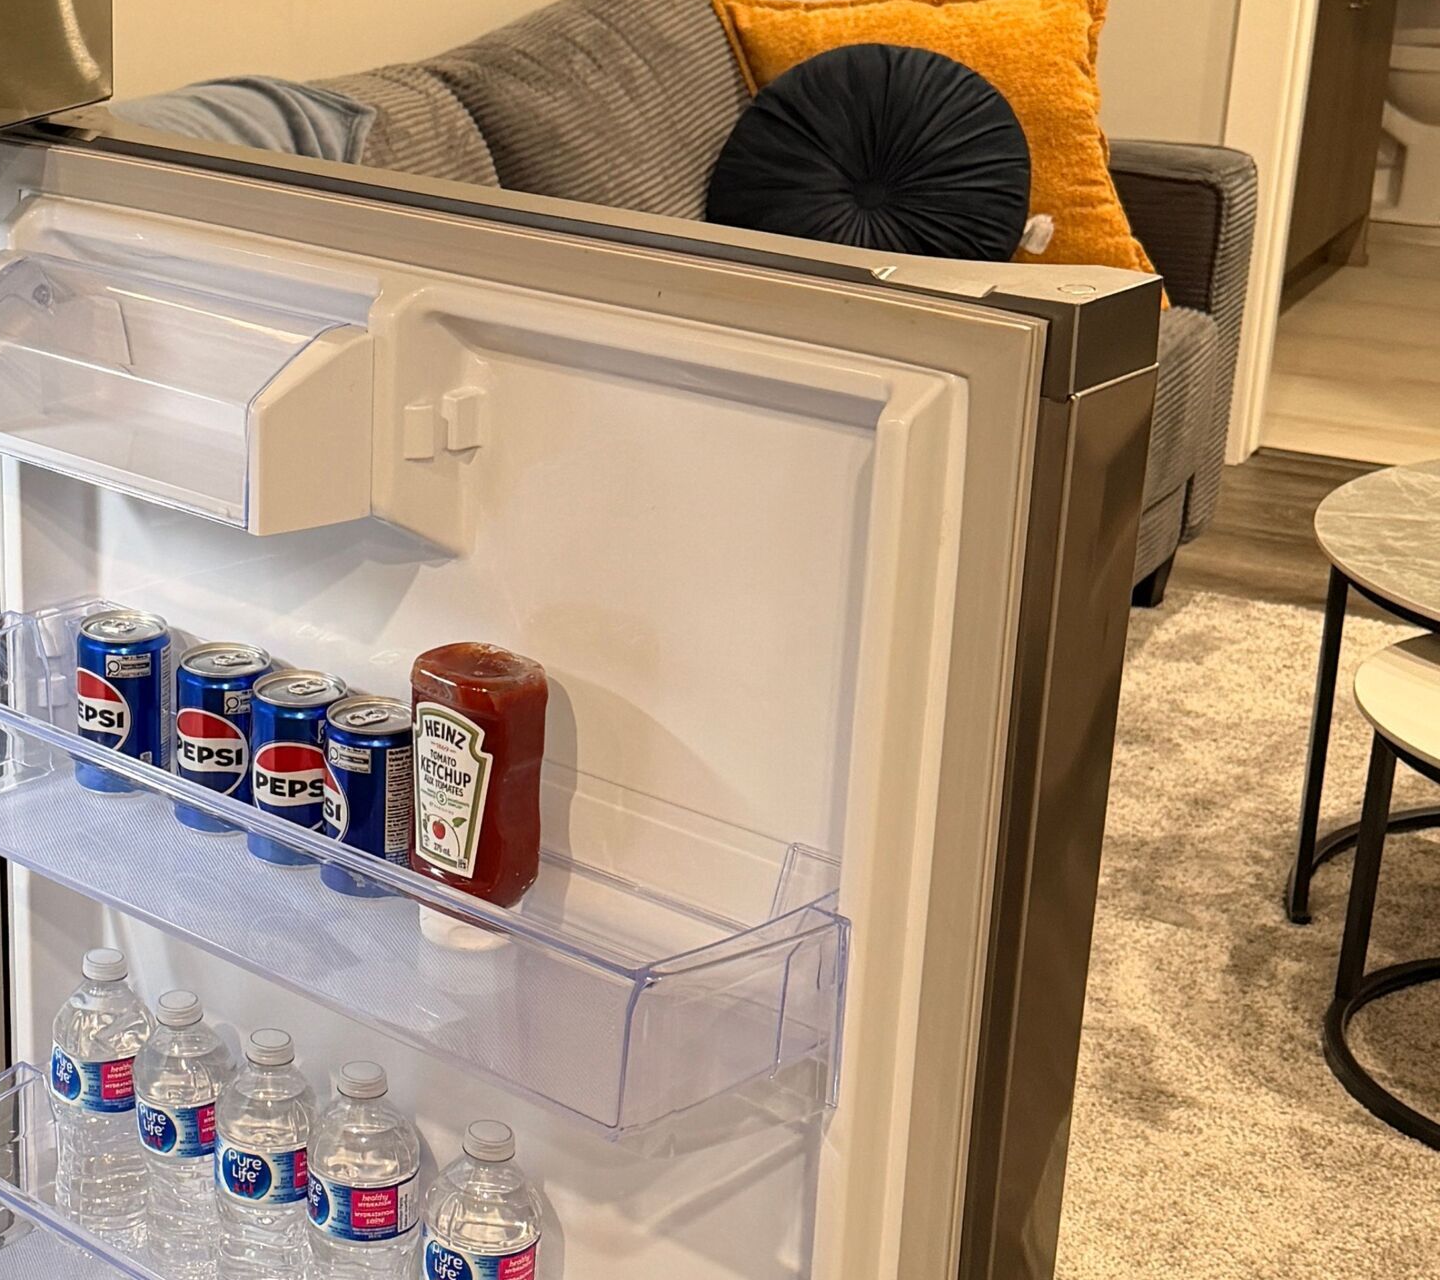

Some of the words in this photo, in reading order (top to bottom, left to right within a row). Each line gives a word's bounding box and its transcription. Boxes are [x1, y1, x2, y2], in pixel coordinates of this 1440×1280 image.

[78, 701, 124, 729] EPSI
[425, 720, 466, 750] HEINZ
[420, 755, 471, 788] KETCHUP
[430, 749, 457, 767] TOMATO
[256, 771, 323, 798] PEPS
[435, 779, 464, 797] TOMATES
